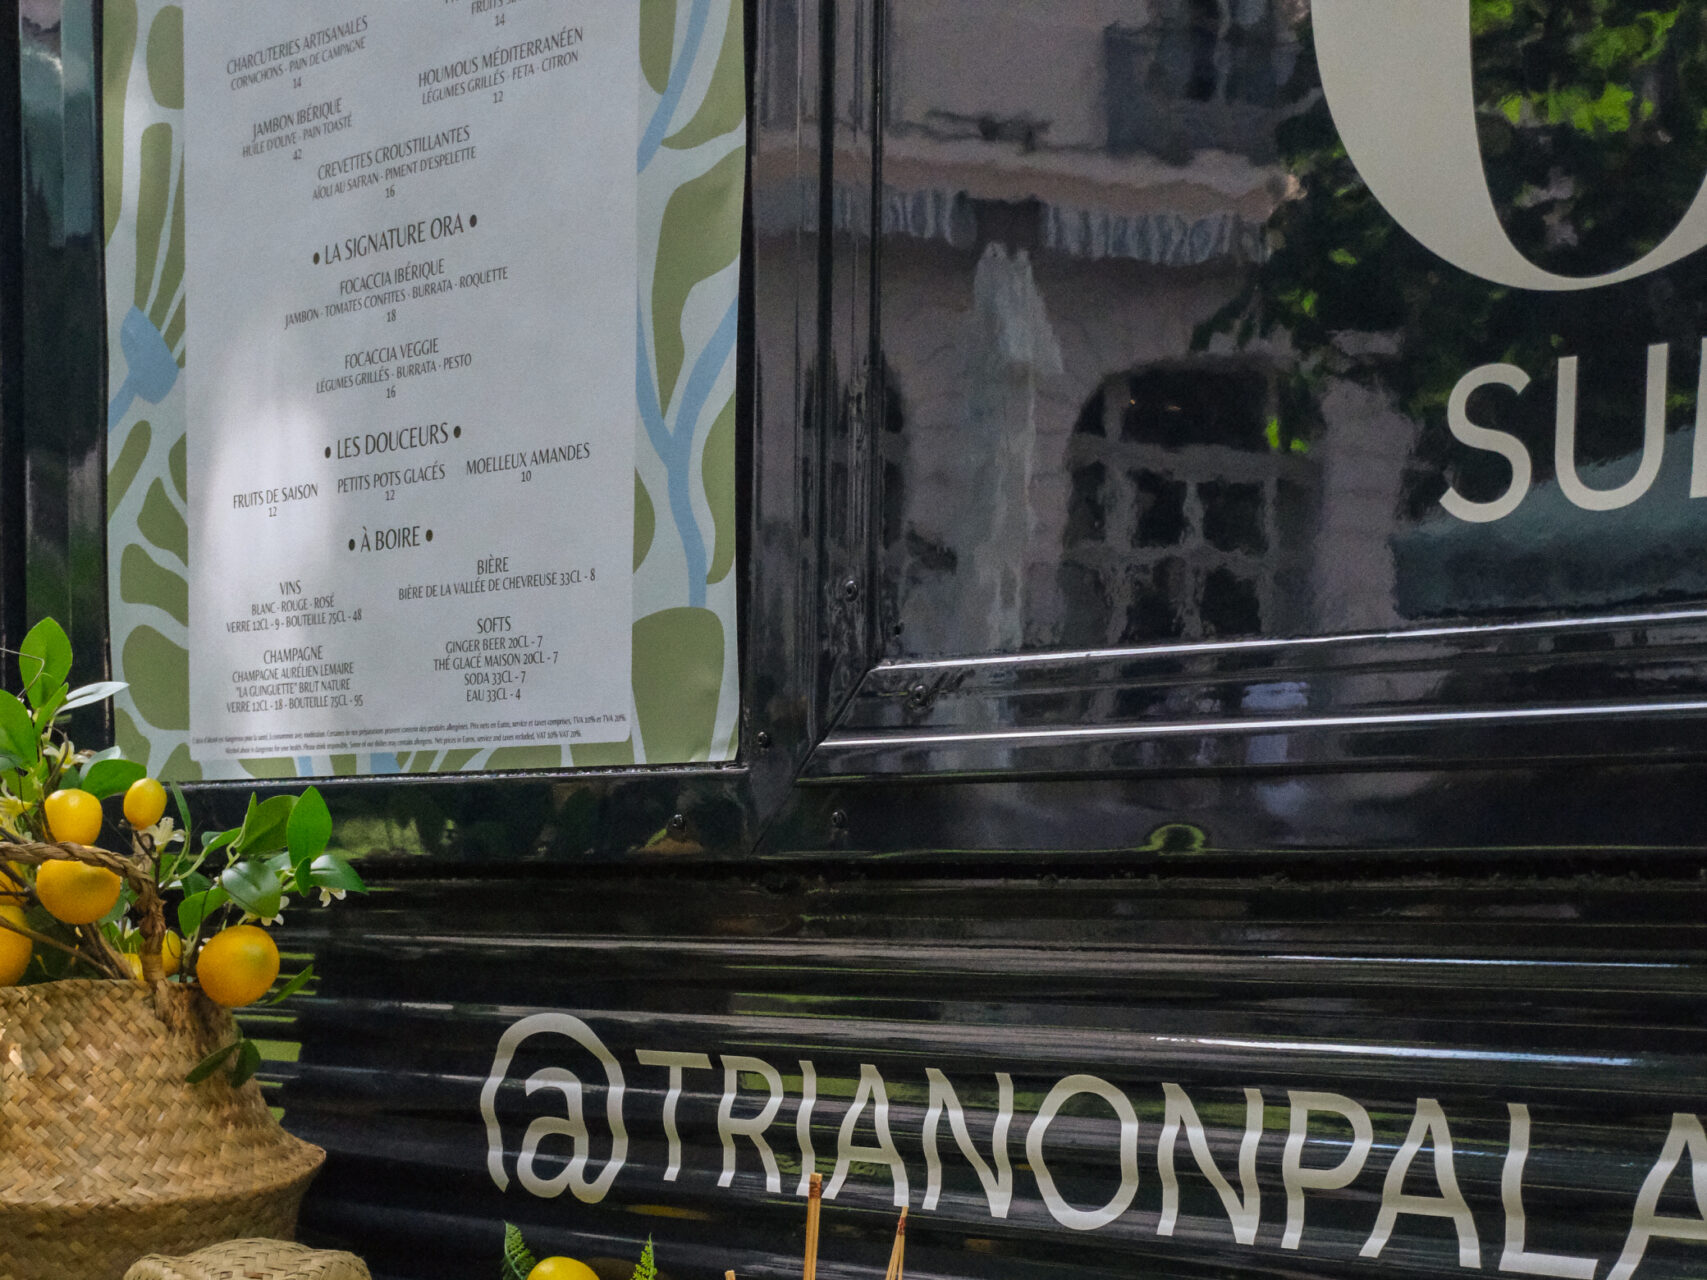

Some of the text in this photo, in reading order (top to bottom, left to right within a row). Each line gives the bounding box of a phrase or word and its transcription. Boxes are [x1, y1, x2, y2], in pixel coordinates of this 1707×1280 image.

[495, 14, 505, 26] 14
[227, 15, 368, 74] CHARCUTERIES ARTISANALES
[418, 26, 583, 87] HOUMOUS MÉDITERRANÉEN
[231, 37, 366, 91] CORNICHONS PAIN DE CAMPAGNE
[422, 51, 579, 105] LÉGUMES GRILLÉS FETA CITRON
[493, 91, 504, 104] 12
[252, 97, 342, 142] JAMBON IBÉRIQUE
[242, 140, 265, 158] HUILE
[303, 126, 321, 141] PAIN
[322, 112, 353, 134] TOASTÉ
[318, 125, 470, 180] CREVETTES CROUSTILLANTES
[334, 181, 345, 194] AU
[347, 172, 379, 191] SAFRAN
[385, 161, 418, 180] PIMENT
[420, 146, 477, 172] D'ESPELETTE
[385, 185, 395, 198] 16
[325, 213, 464, 265] LA SIGNATURE ORA
[340, 258, 445, 296] FOCACCIA IBÉRIQUE
[285, 266, 508, 329] JAMBON TOMATES CONFITES BURRATA ROQUETTE
[386, 309, 396, 323] 18
[344, 338, 439, 370] FOCACCIA VEGGIE
[316, 353, 472, 394] LÉGUMES GRILLÉS BURRATA PESTO
[386, 385, 396, 399] 16
[337, 422, 449, 459] LES DOUCEURS
[1439, 337, 1707, 522] SU
[466, 442, 590, 475] MOELLEUX AMANDES
[337, 461, 446, 493] PETITS POTS GLACÉS
[521, 470, 532, 482] 10
[233, 483, 318, 509] FRUITS DE SAISON
[385, 490, 395, 501] 12
[268, 506, 277, 517] 12
[360, 526, 421, 552] À BOIRE
[477, 554, 510, 575] BIÈRE
[280, 579, 302, 596] VINS
[398, 568, 596, 600] BIÈRE DE LA VALLÉE DE CHEVREUSE 33CL 8
[251, 592, 335, 616] BLANC ROUGE ROSÉ
[226, 608, 363, 633] VERRE 12CL 9 BOUTEILLE 75CL 48
[477, 615, 513, 634] SOFTS
[263, 645, 324, 665] CHAMPAGNE
[445, 635, 543, 654] GINGER BEER 20CL 7
[232, 661, 355, 683] CHAMPAGNE AURÉLIEN LEMAIRE
[433, 650, 559, 671] THÉ GLACÉ MAISON 20CL 7
[299, 680, 320, 693] BRUT
[321, 678, 351, 692] NATURE
[464, 670, 526, 686] SODA 33CL 7
[226, 700, 251, 713] VERRE
[252, 698, 268, 712] 12CL
[288, 694, 329, 710] BOUTEILLE
[466, 687, 521, 703] EAU 33CL 4
